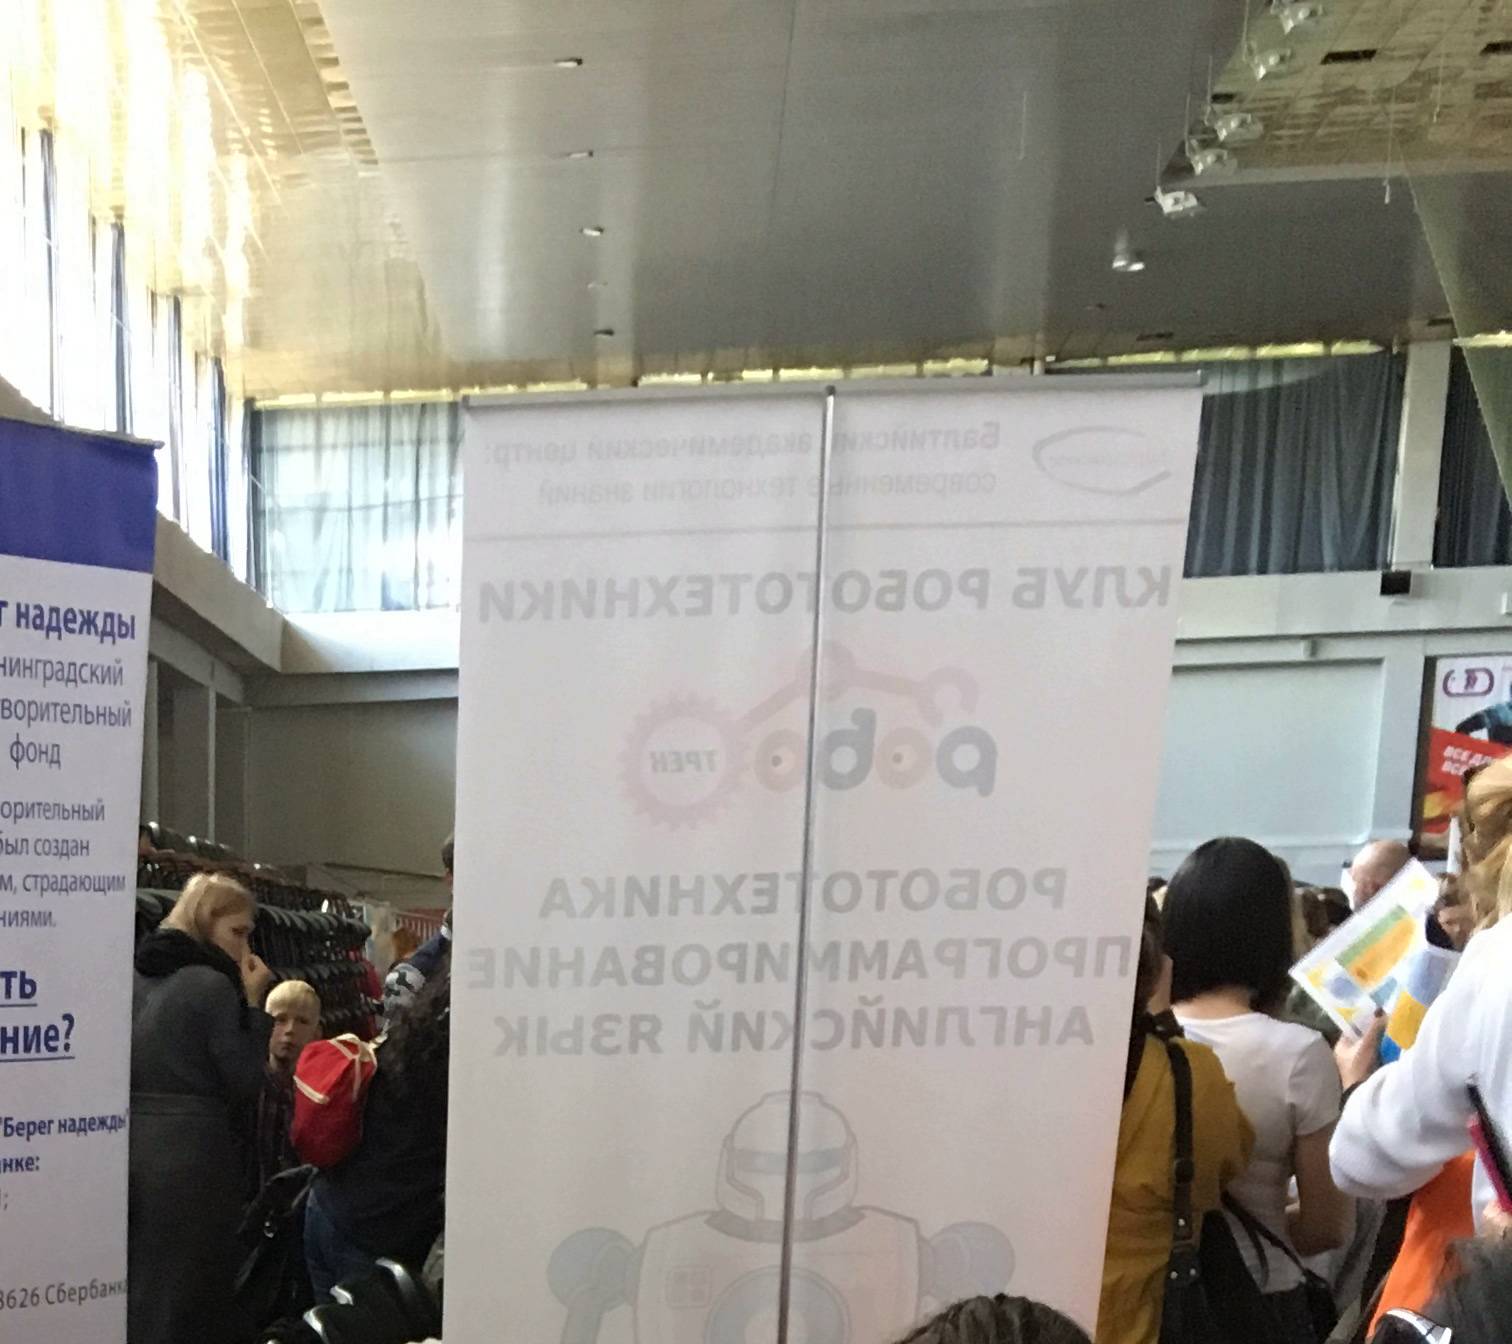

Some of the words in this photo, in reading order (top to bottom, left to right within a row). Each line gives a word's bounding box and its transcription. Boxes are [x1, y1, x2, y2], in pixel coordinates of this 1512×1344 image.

[15, 601, 136, 645] надежды
[10, 734, 61, 770] фонд
[34, 836, 90, 858] создан
[22, 872, 126, 896] страдающим
